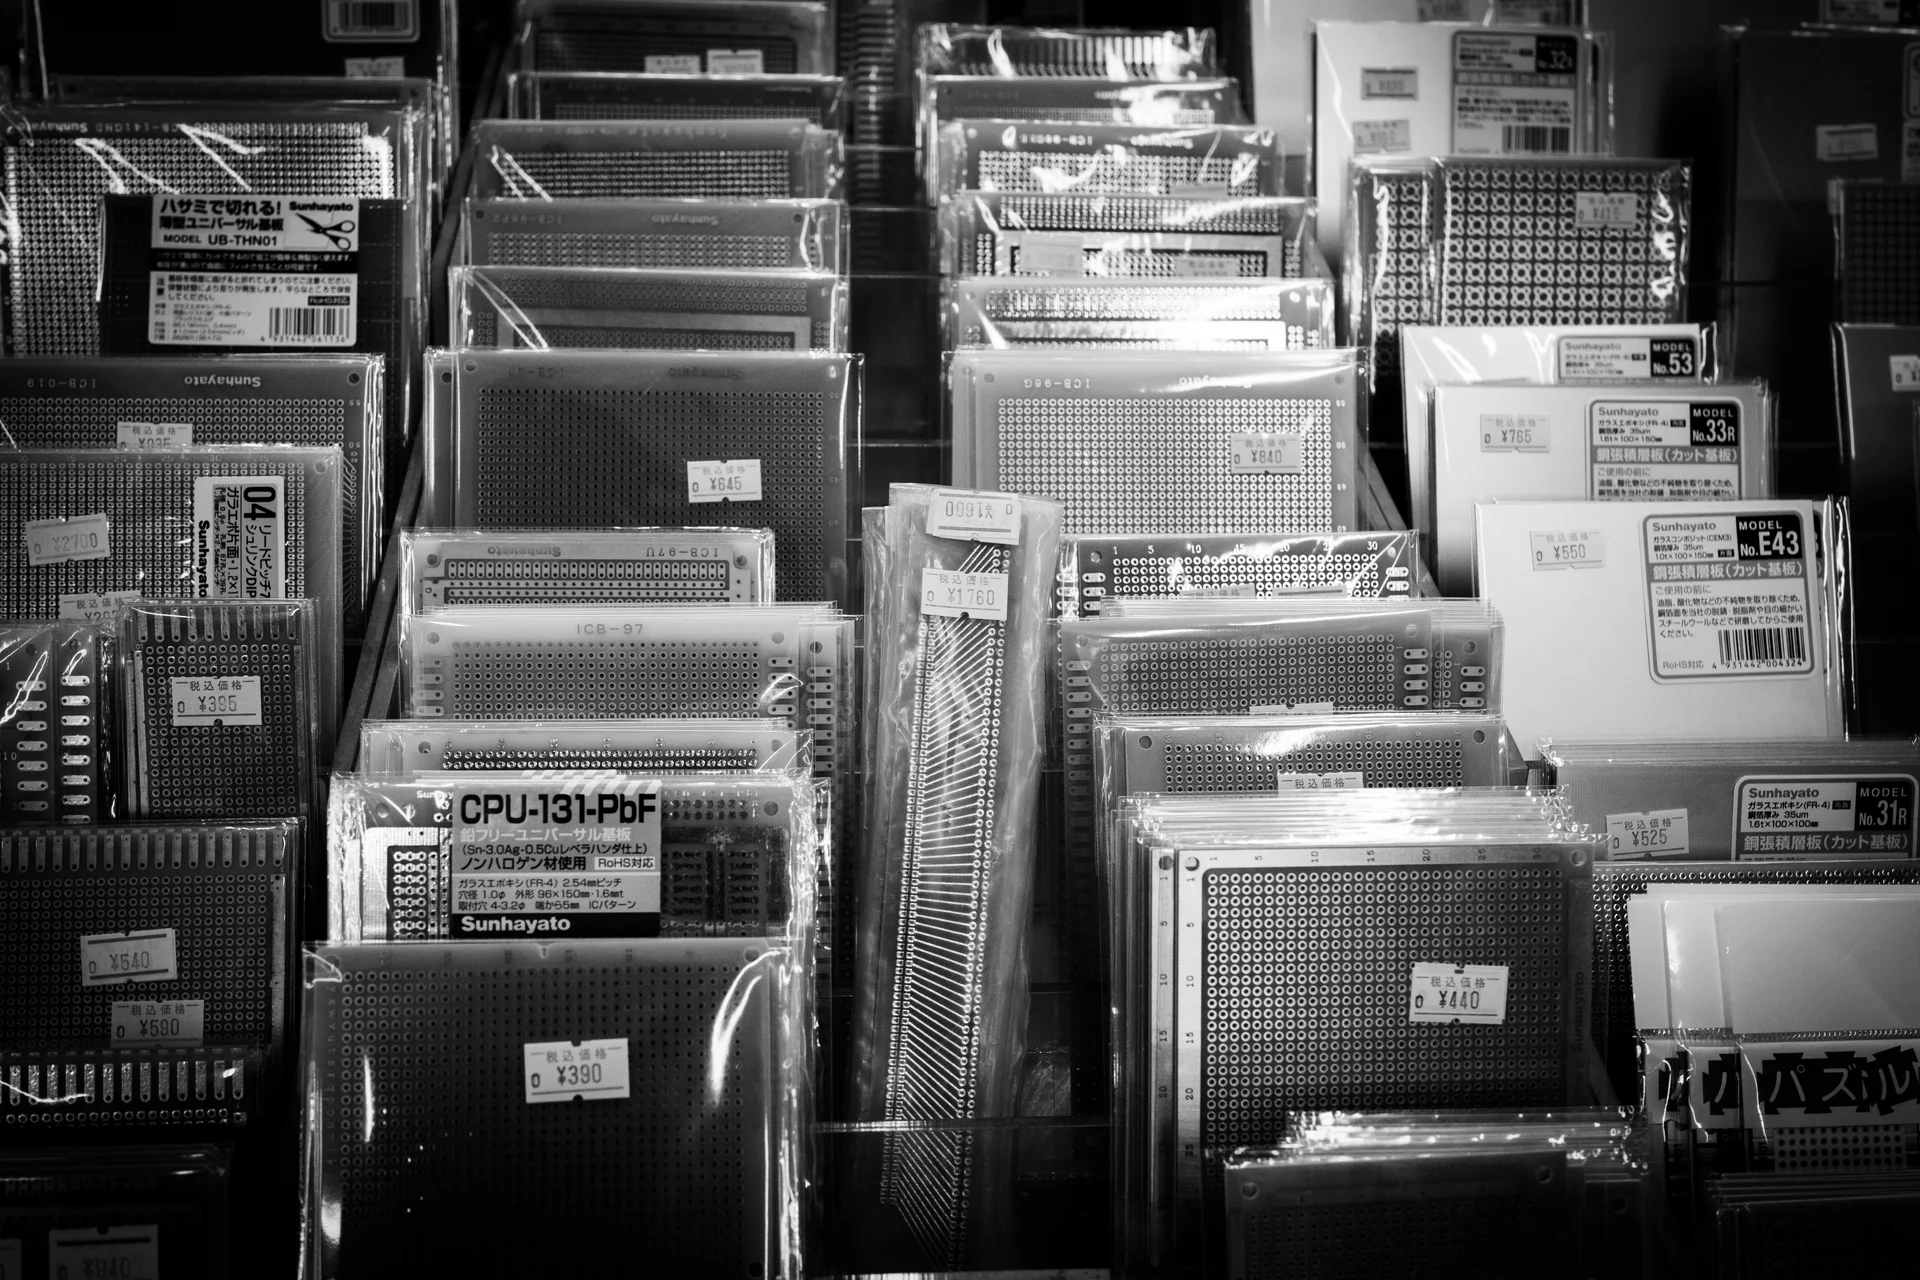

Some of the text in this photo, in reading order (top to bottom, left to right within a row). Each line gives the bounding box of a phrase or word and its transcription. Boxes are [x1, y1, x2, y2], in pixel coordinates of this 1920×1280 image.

[289, 202, 354, 212] Sunhayato
[159, 216, 284, 232] 薄型ユニバーサル基板
[163, 234, 277, 246] MODEL UB-THN01
[1653, 343, 1690, 352] MODEL
[1653, 353, 1692, 374] No.53
[27, 375, 261, 388] Sunhayato ICB-019
[1024, 378, 1090, 388] ICB-96G
[1598, 407, 1734, 417] Sunhayato MODEL
[133, 426, 175, 436] 税込価格
[1502, 429, 1532, 444] ¥765
[1692, 419, 1735, 442] No.33R
[1251, 450, 1282, 464] ¥840
[710, 476, 742, 491] ¥645
[244, 486, 276, 520] 04
[945, 500, 993, 518] ¥1600
[1652, 520, 1782, 532] Sunhayato MODEL
[1546, 532, 1588, 542] 税込価格
[1740, 530, 1800, 556] No.E43
[1148, 545, 1154, 554] 5
[1191, 544, 1201, 553] 10
[1367, 542, 1378, 551] 30
[1554, 544, 1586, 560] ¥550
[197, 520, 210, 598] Sunhayato
[1652, 561, 1802, 580] 銅張積層板(カット基板)
[938, 573, 990, 586] 税込価格
[1656, 584, 1712, 595] ご使用の前に
[926, 588, 996, 606] 0 ¥1760
[576, 624, 643, 634] ICB-97
[1662, 660, 1704, 669] RoHS対応
[190, 680, 243, 691] 税込価格
[177, 695, 237, 713] 0 ¥395
[1295, 778, 1345, 789] 税込価格
[1748, 788, 1908, 800] Sunhayato MODEL
[460, 794, 656, 824] CPU-131-PbF
[1748, 801, 1831, 810] ガラスエポキシ(FR-4)
[1859, 800, 1907, 826] No.31R
[1624, 818, 1671, 830] 税込価格
[460, 827, 632, 842] 鉛フリーユニバーサル基板
[1632, 829, 1667, 847] ¥525
[1744, 834, 1908, 850] 銅張積層板(カット基板)
[461, 857, 654, 870] ノンハロゲン材使用 RoHS対応
[458, 878, 558, 888] ガラスエポキシ(FR-4)
[458, 890, 478, 900] 穴径
[515, 890, 534, 900] 外形
[458, 901, 487, 910] 取付穴
[589, 901, 636, 910] ICパターン
[461, 916, 571, 934] Sunhayato
[88, 950, 150, 974] 0 ¥540
[1430, 976, 1485, 988] 税込価格
[1415, 991, 1479, 1009] 0 ¥440
[131, 1004, 186, 1015] 税込価格
[117, 1018, 180, 1039] 0 ¥590
[546, 1048, 606, 1063] 税込価格
[531, 1063, 601, 1088] 0 ¥390
[1769, 1063, 1910, 1102] パズル
